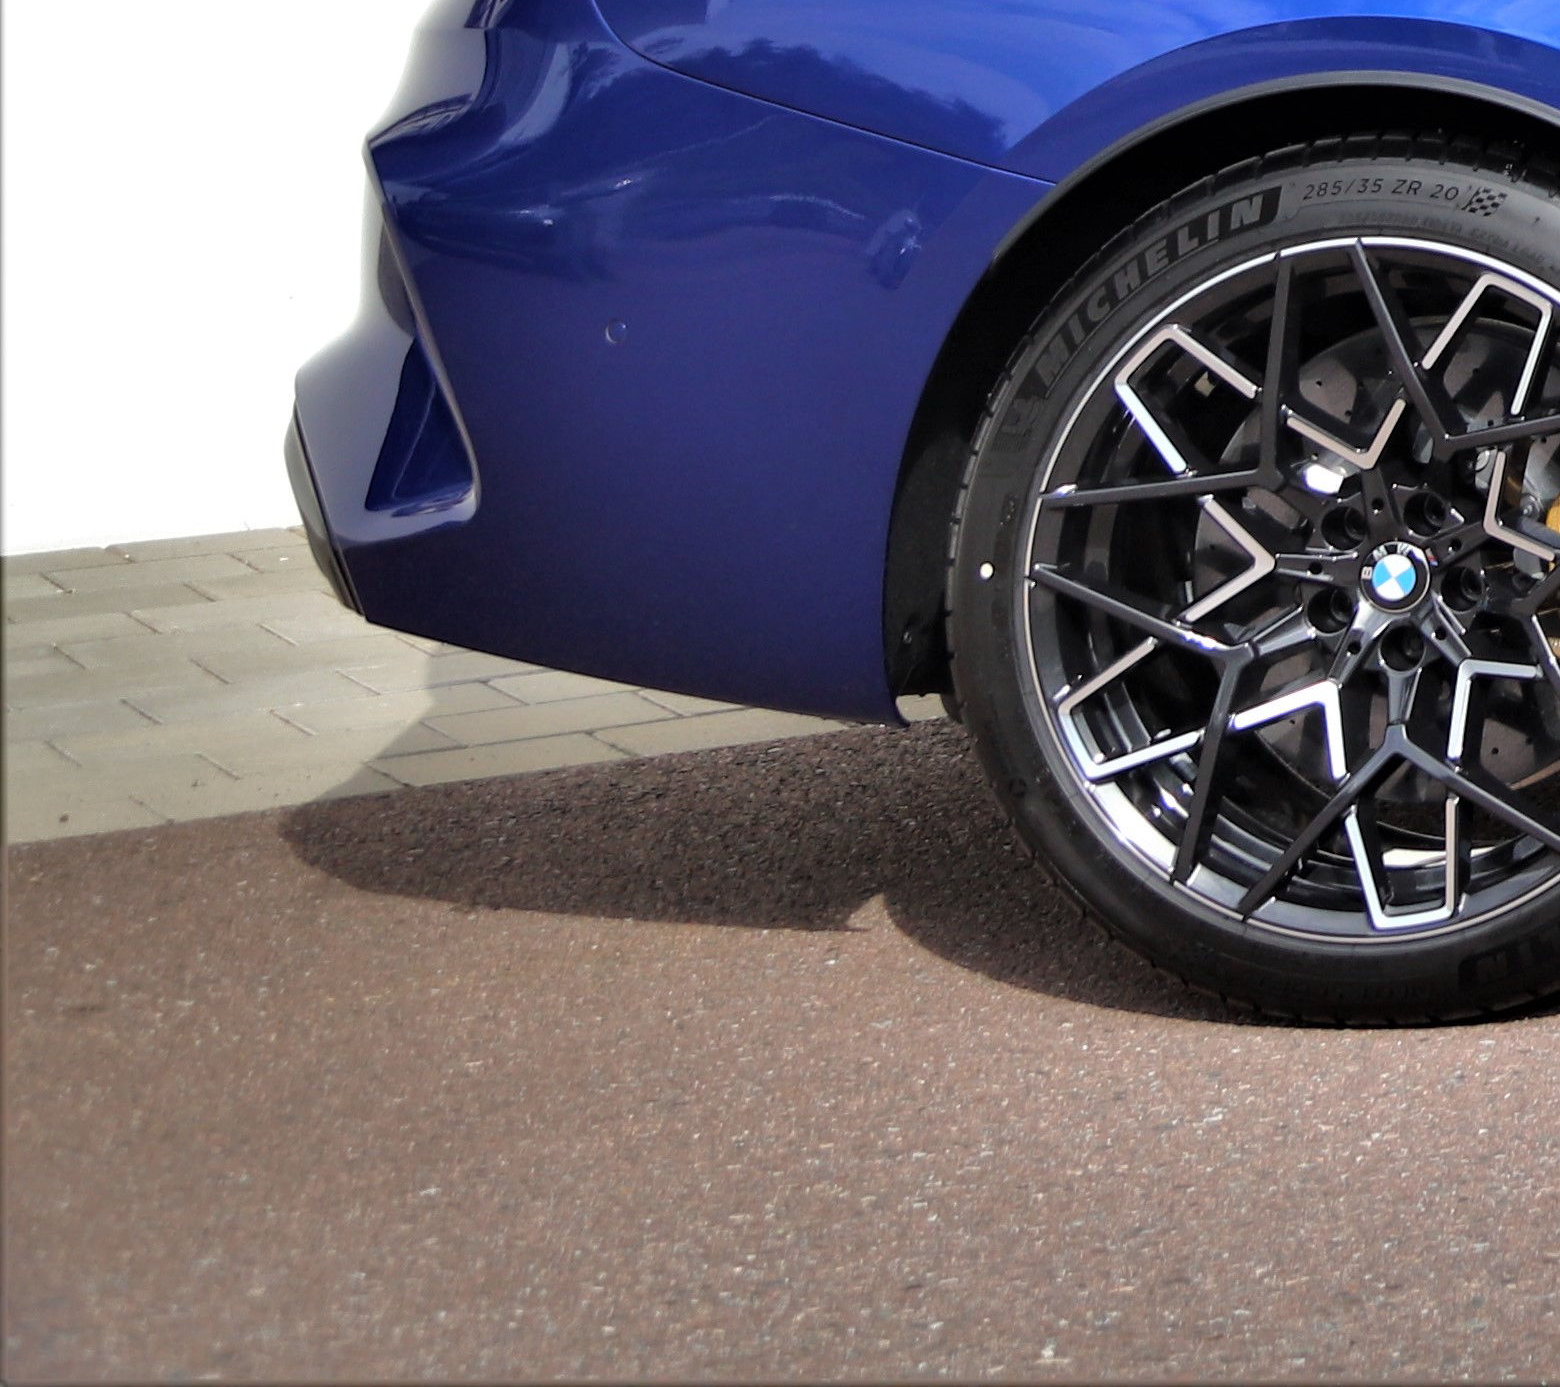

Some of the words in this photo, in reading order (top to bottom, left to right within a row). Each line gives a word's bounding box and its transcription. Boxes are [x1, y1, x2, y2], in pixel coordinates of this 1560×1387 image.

[1034, 192, 1264, 384] MICHELIN
[1303, 178, 1384, 201] 285/35
[1391, 179, 1423, 196] ZR
[1429, 183, 1460, 201] 20
